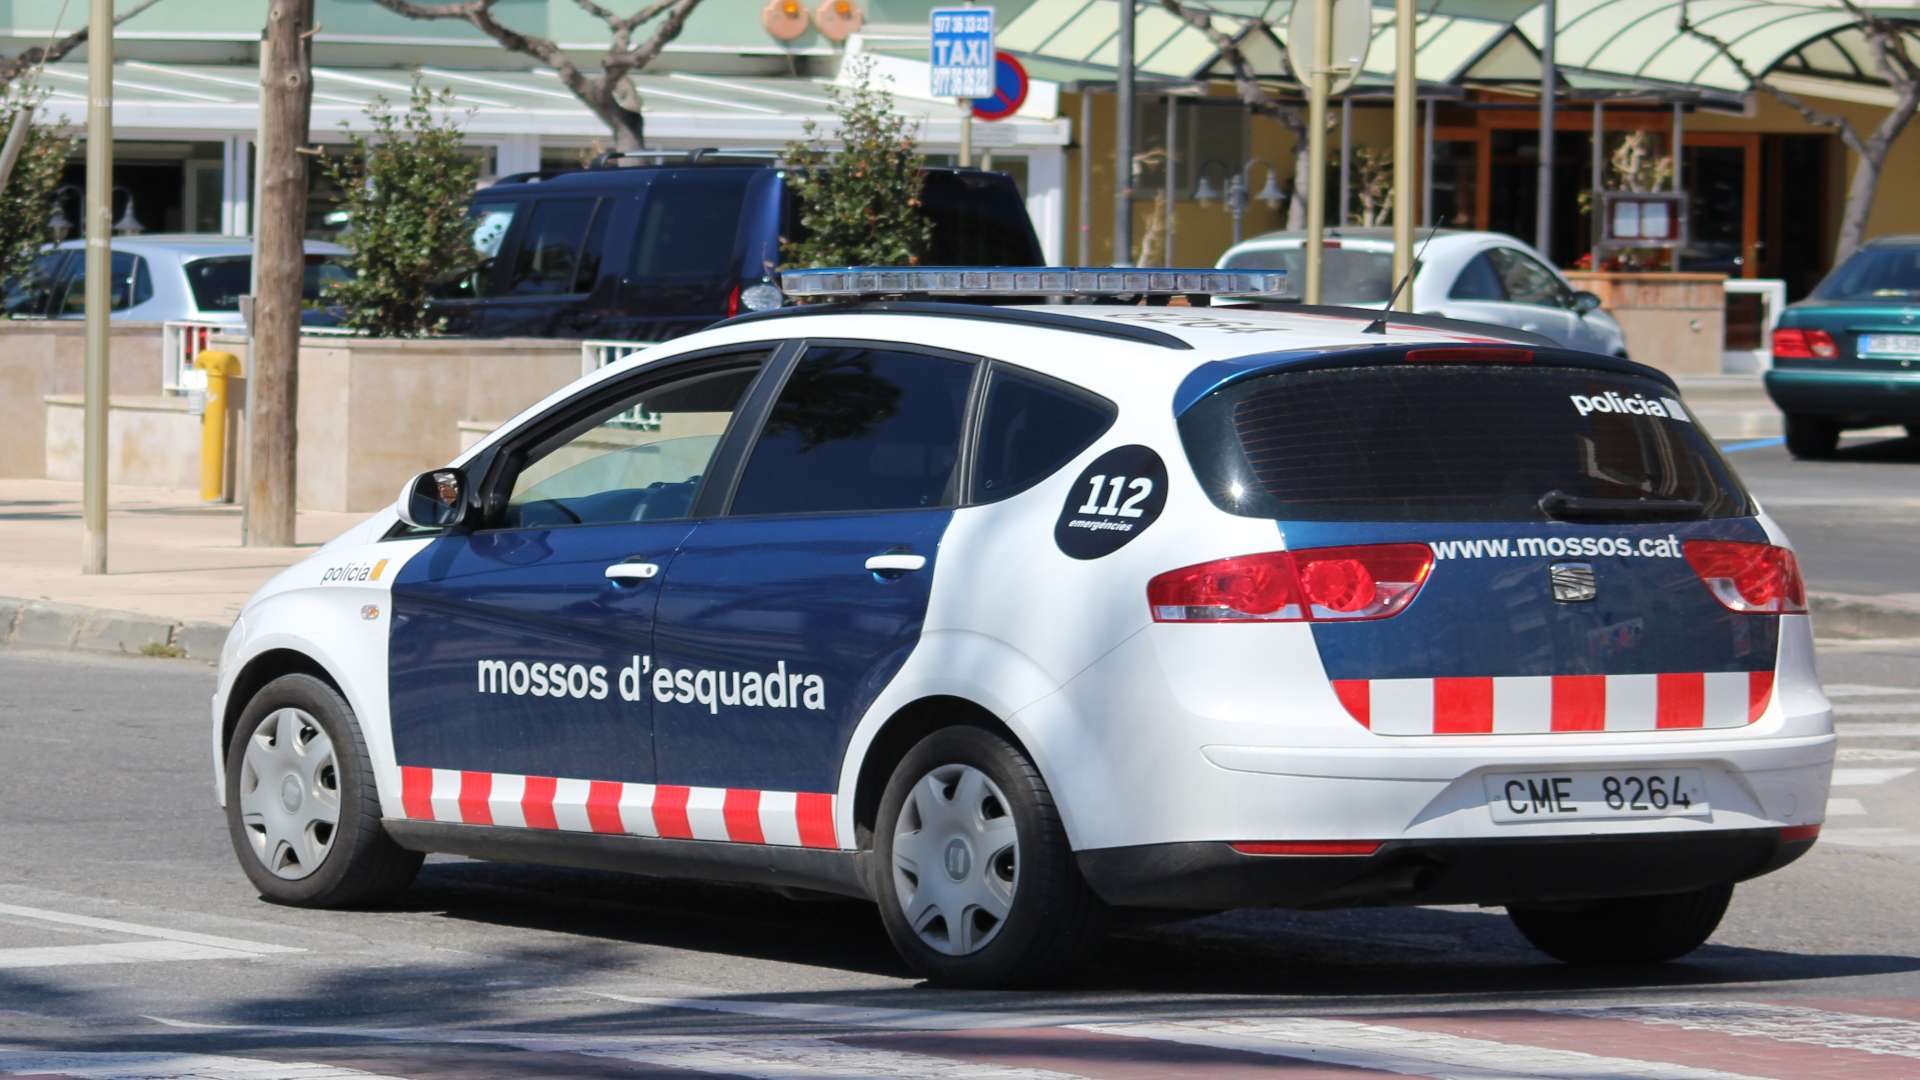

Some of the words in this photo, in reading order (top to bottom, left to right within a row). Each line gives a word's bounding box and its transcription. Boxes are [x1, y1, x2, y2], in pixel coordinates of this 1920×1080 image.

[934, 16, 951, 33] 977
[976, 16, 989, 33] 23
[934, 39, 988, 66] TAXI
[934, 67, 951, 96] 977
[1568, 391, 1669, 418] policia
[1077, 474, 1153, 518] 112
[1428, 534, 1683, 561] www.mossos.cat
[320, 562, 371, 586] policia
[477, 659, 609, 700] mossos
[618, 654, 826, 715] d'esquadra
[1504, 777, 1578, 815] CME
[1602, 775, 1691, 811] 8264
